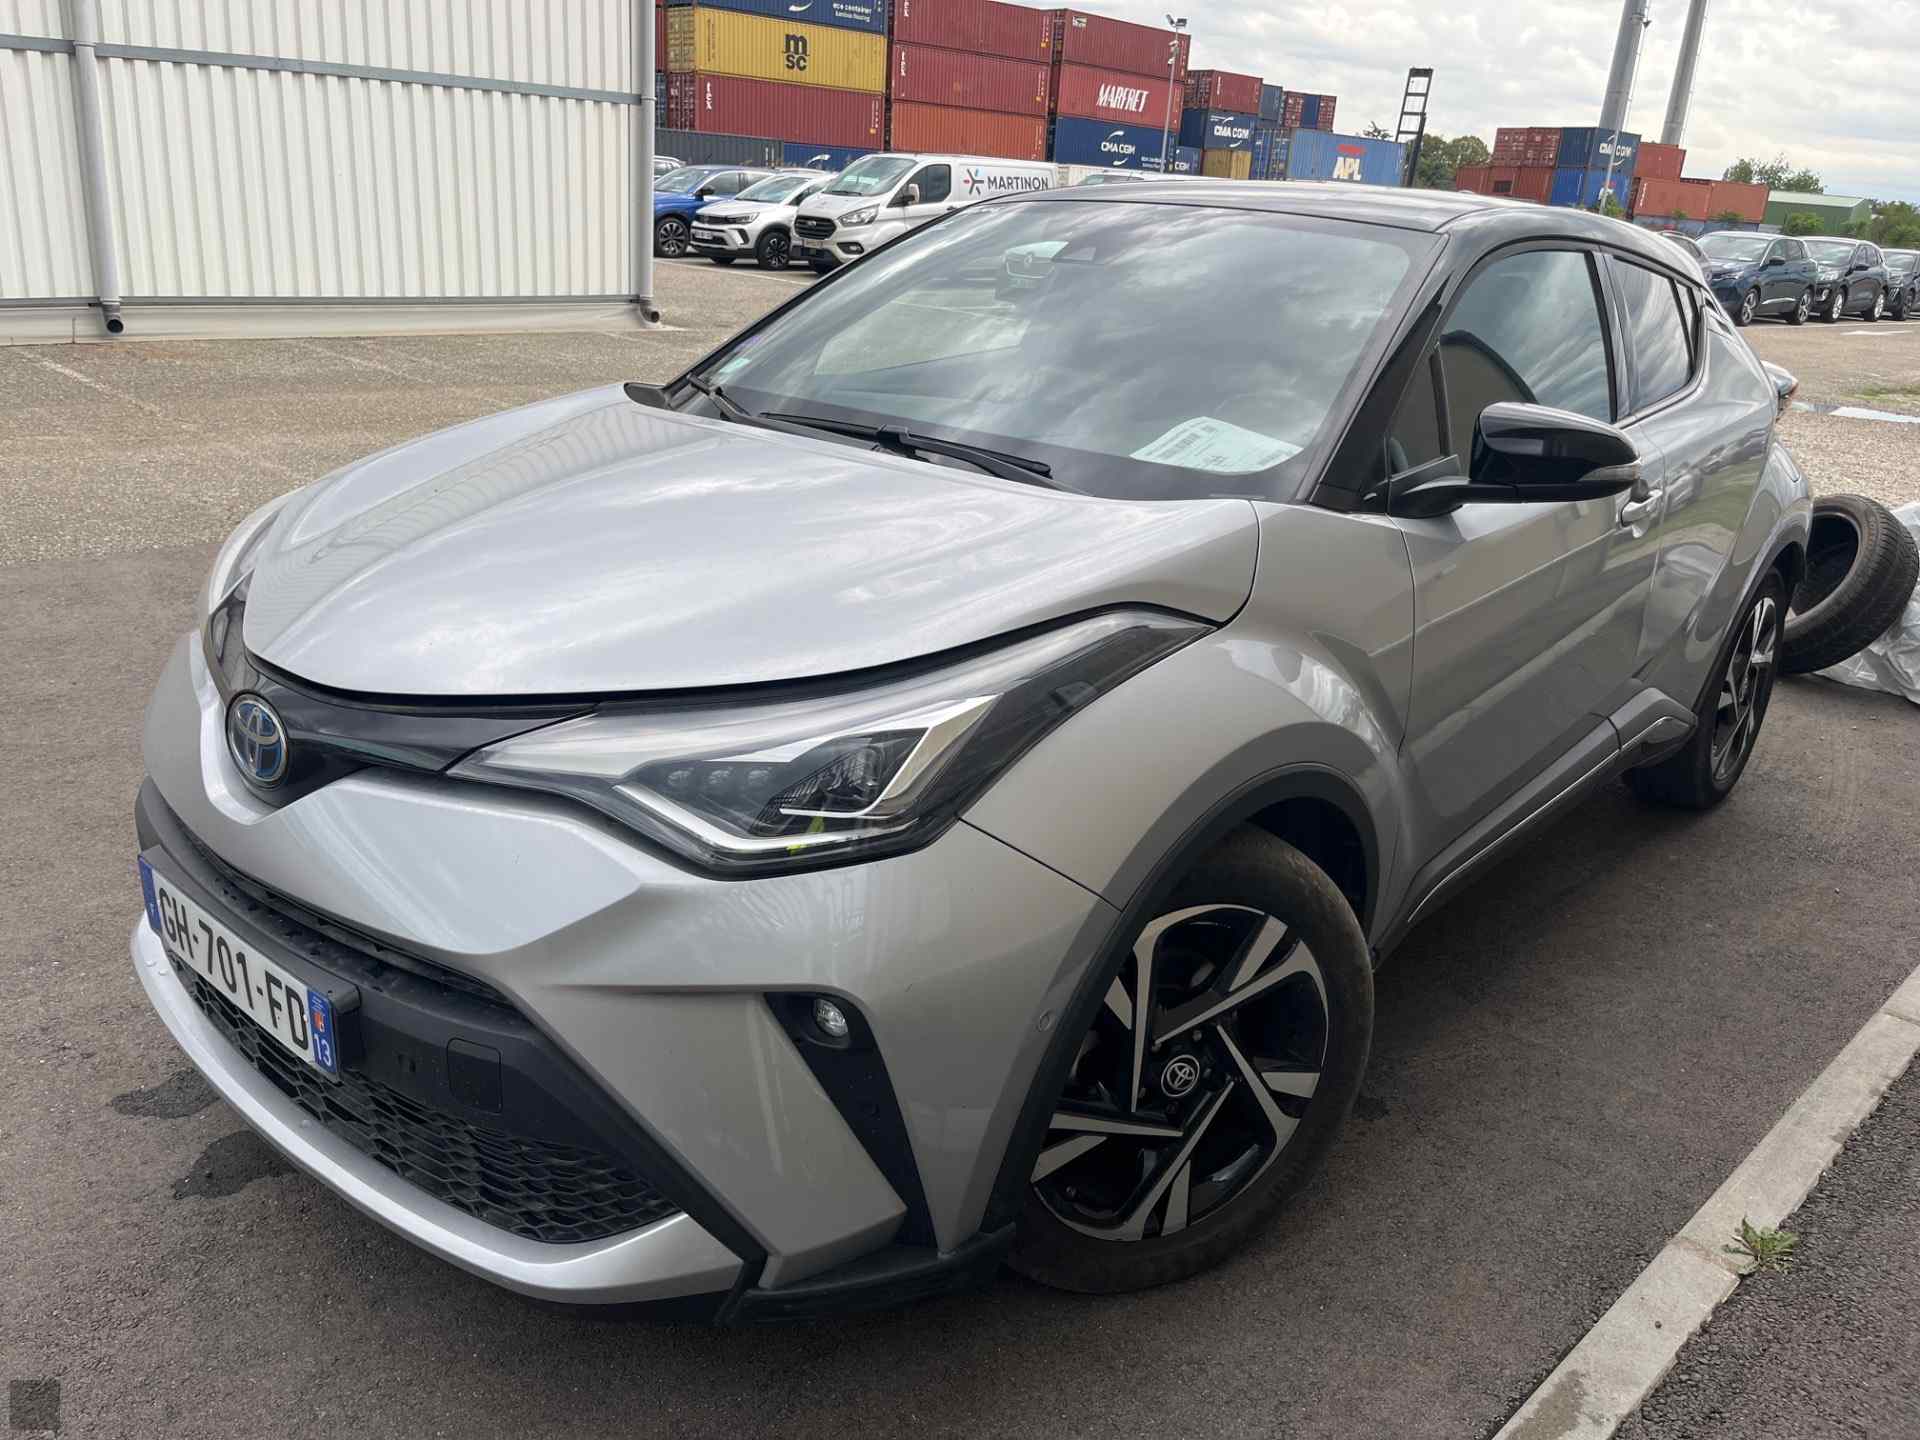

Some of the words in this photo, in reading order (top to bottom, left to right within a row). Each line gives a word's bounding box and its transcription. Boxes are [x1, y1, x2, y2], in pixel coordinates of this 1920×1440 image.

[1096, 84, 1149, 112] MARFRET
[1100, 141, 1118, 153] CMA
[1118, 143, 1136, 155] CGM
[1332, 156, 1362, 181] APL
[987, 175, 1049, 192] MARTINON
[158, 887, 309, 1051] GH-701-FD
[312, 1033, 333, 1068] 13
